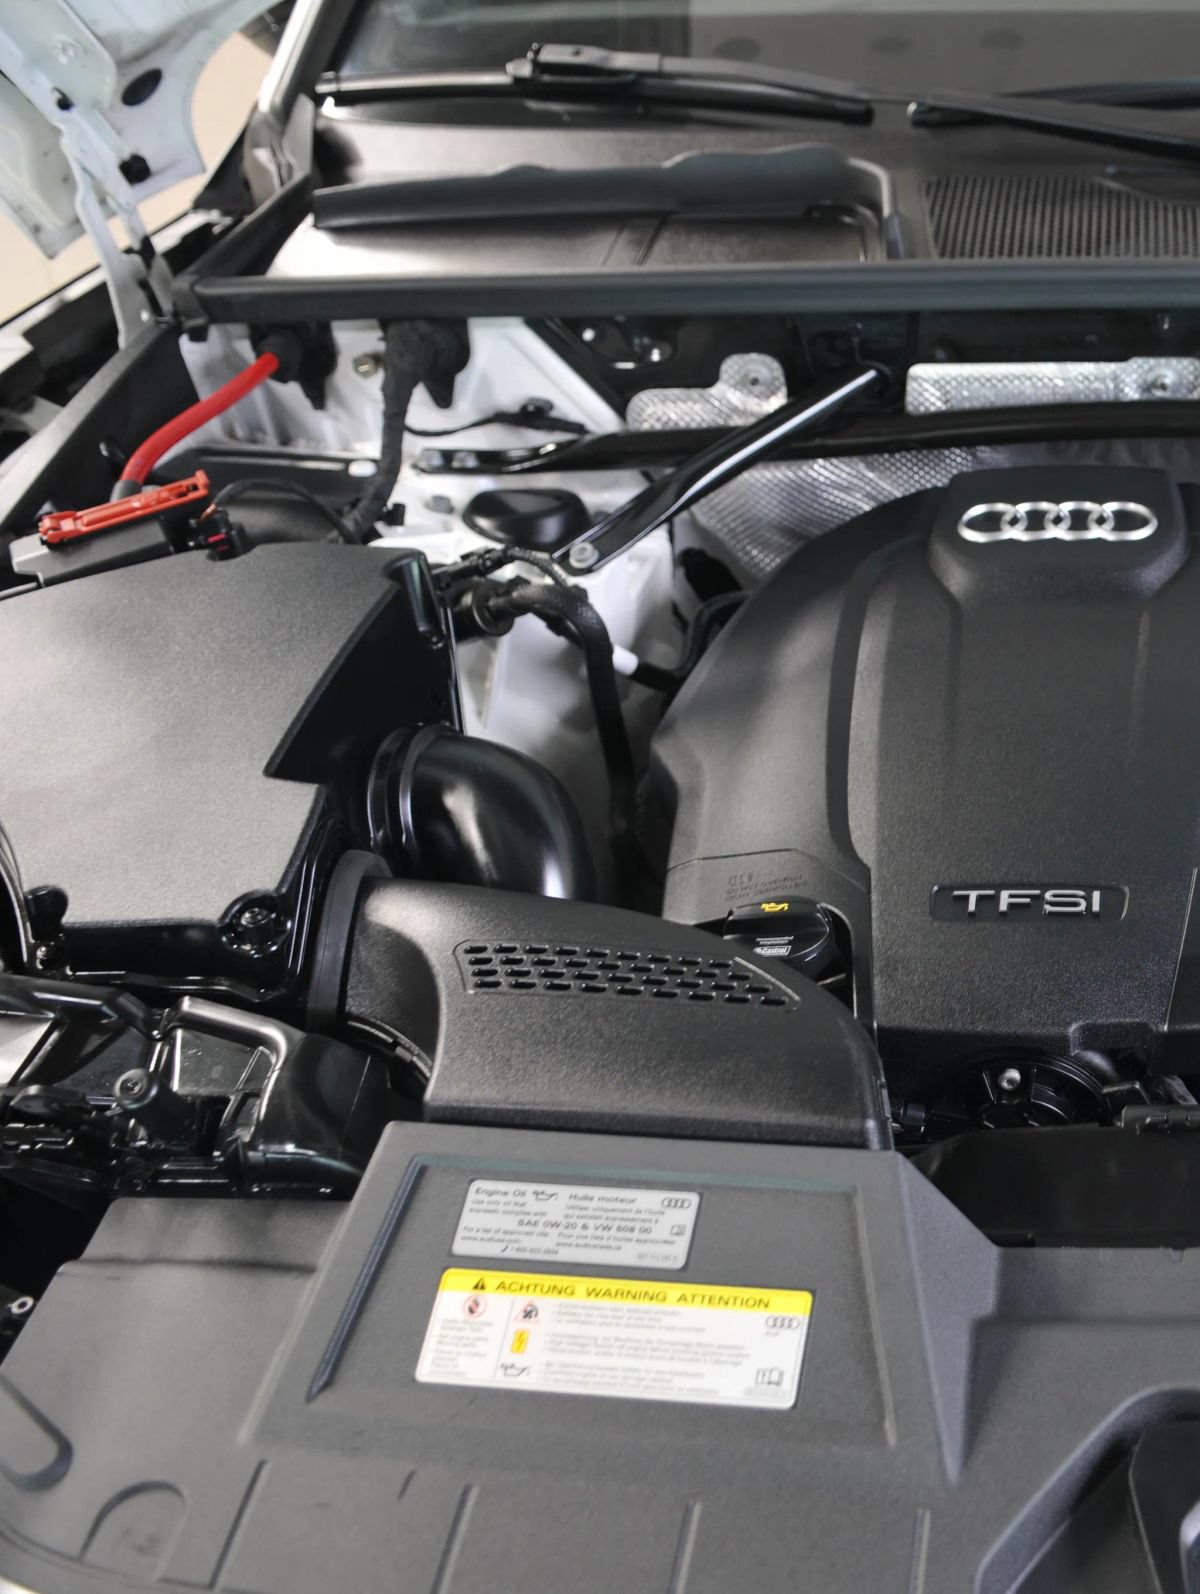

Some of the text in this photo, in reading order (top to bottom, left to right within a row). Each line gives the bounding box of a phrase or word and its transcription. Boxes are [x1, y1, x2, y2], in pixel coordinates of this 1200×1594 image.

[952, 889, 1101, 915] TFSI
[761, 947, 788, 955] Castrol
[475, 1187, 526, 1198] Engine Oil
[568, 1193, 637, 1204] Huile moteur
[518, 1219, 539, 1227] SAE
[580, 1222, 589, 1231] &
[594, 1224, 614, 1232] VW
[638, 1226, 653, 1234] 00
[496, 1279, 770, 1309] ACHTUNG WARNING ATTENTION
